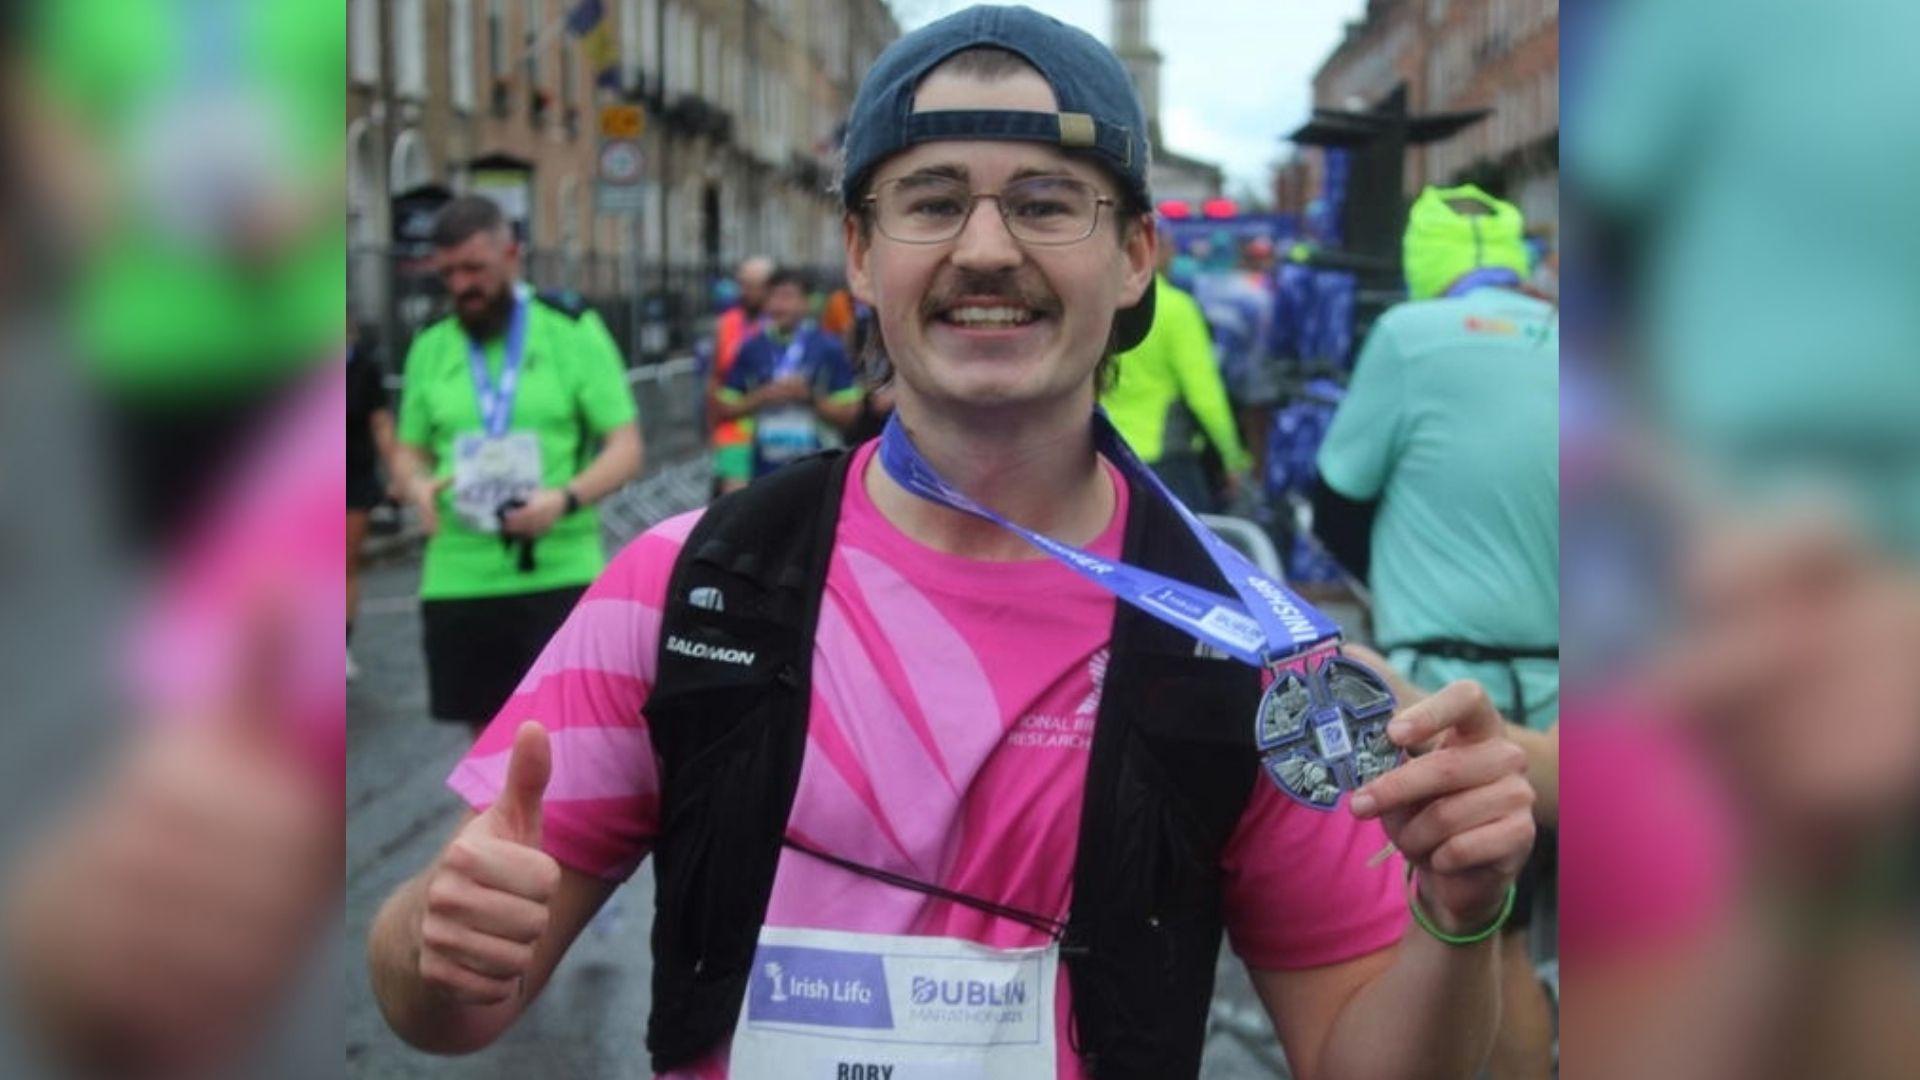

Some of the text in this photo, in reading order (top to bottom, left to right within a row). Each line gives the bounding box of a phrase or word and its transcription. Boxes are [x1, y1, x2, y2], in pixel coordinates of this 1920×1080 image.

[666, 635, 755, 666] SALOMON
[790, 976, 871, 1004] Irish Life
[911, 975, 1026, 1006] DUBLIN
